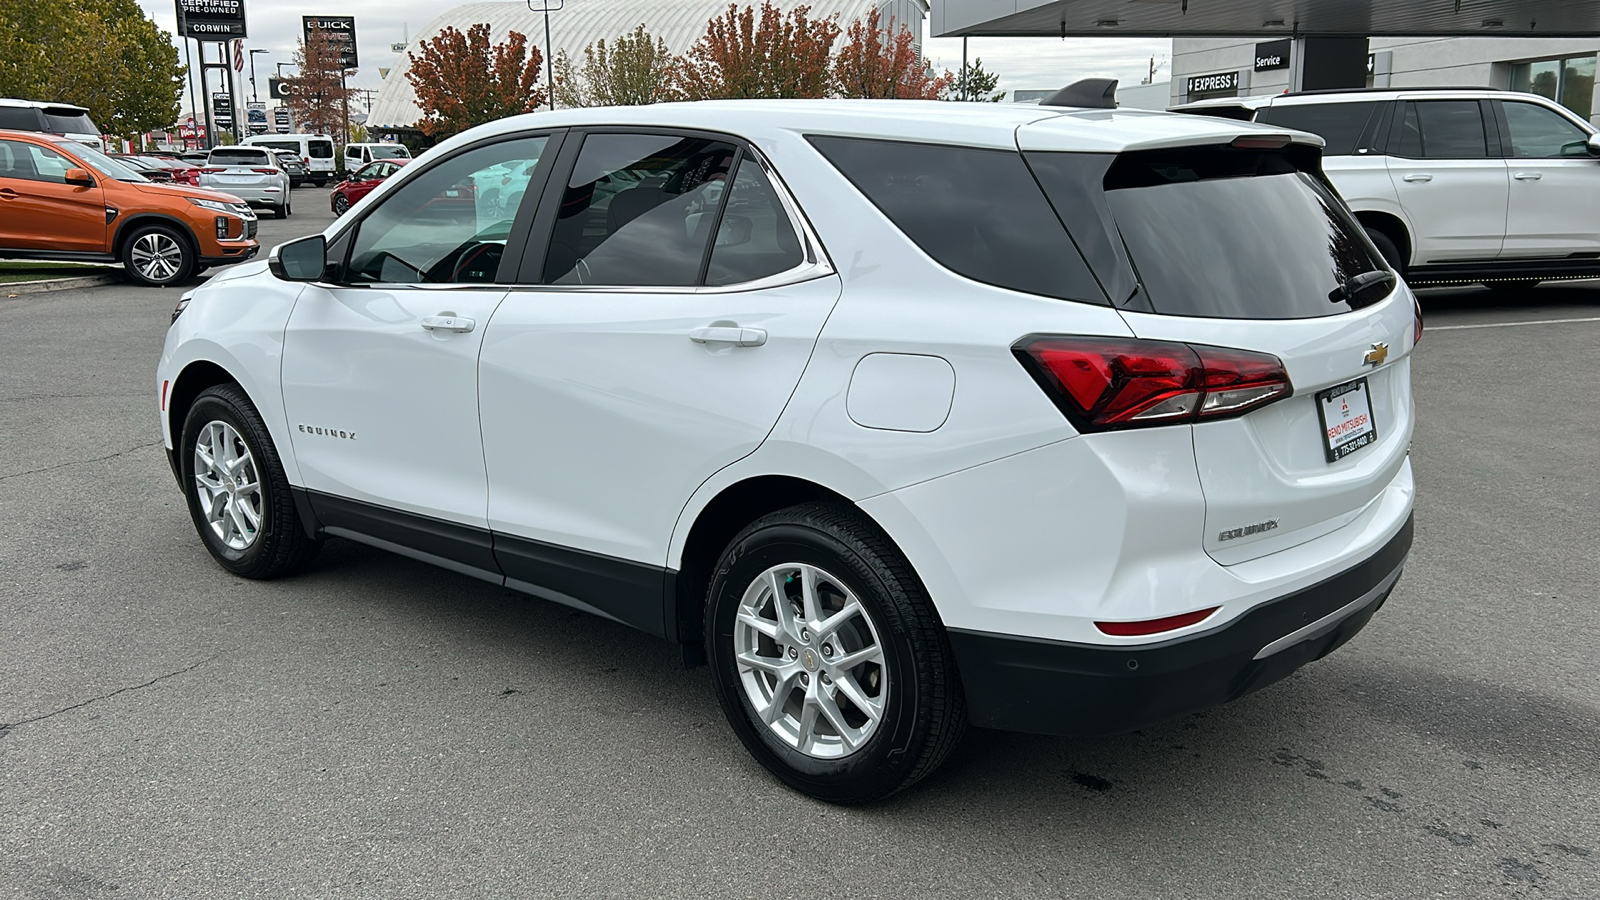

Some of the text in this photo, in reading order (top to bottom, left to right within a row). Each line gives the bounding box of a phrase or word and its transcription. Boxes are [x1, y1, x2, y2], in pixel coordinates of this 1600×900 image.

[183, 6, 237, 14] PRE-OWNED
[193, 24, 231, 33] CORWIN
[307, 21, 350, 29] BUICK
[1256, 55, 1280, 67] Service
[1194, 75, 1231, 91] EXPRESS
[180, 128, 205, 138] Weny's
[1327, 424, 1341, 438] RENO
[1341, 413, 1368, 433] MITSUBISHI
[298, 424, 357, 440] EQUINOX
